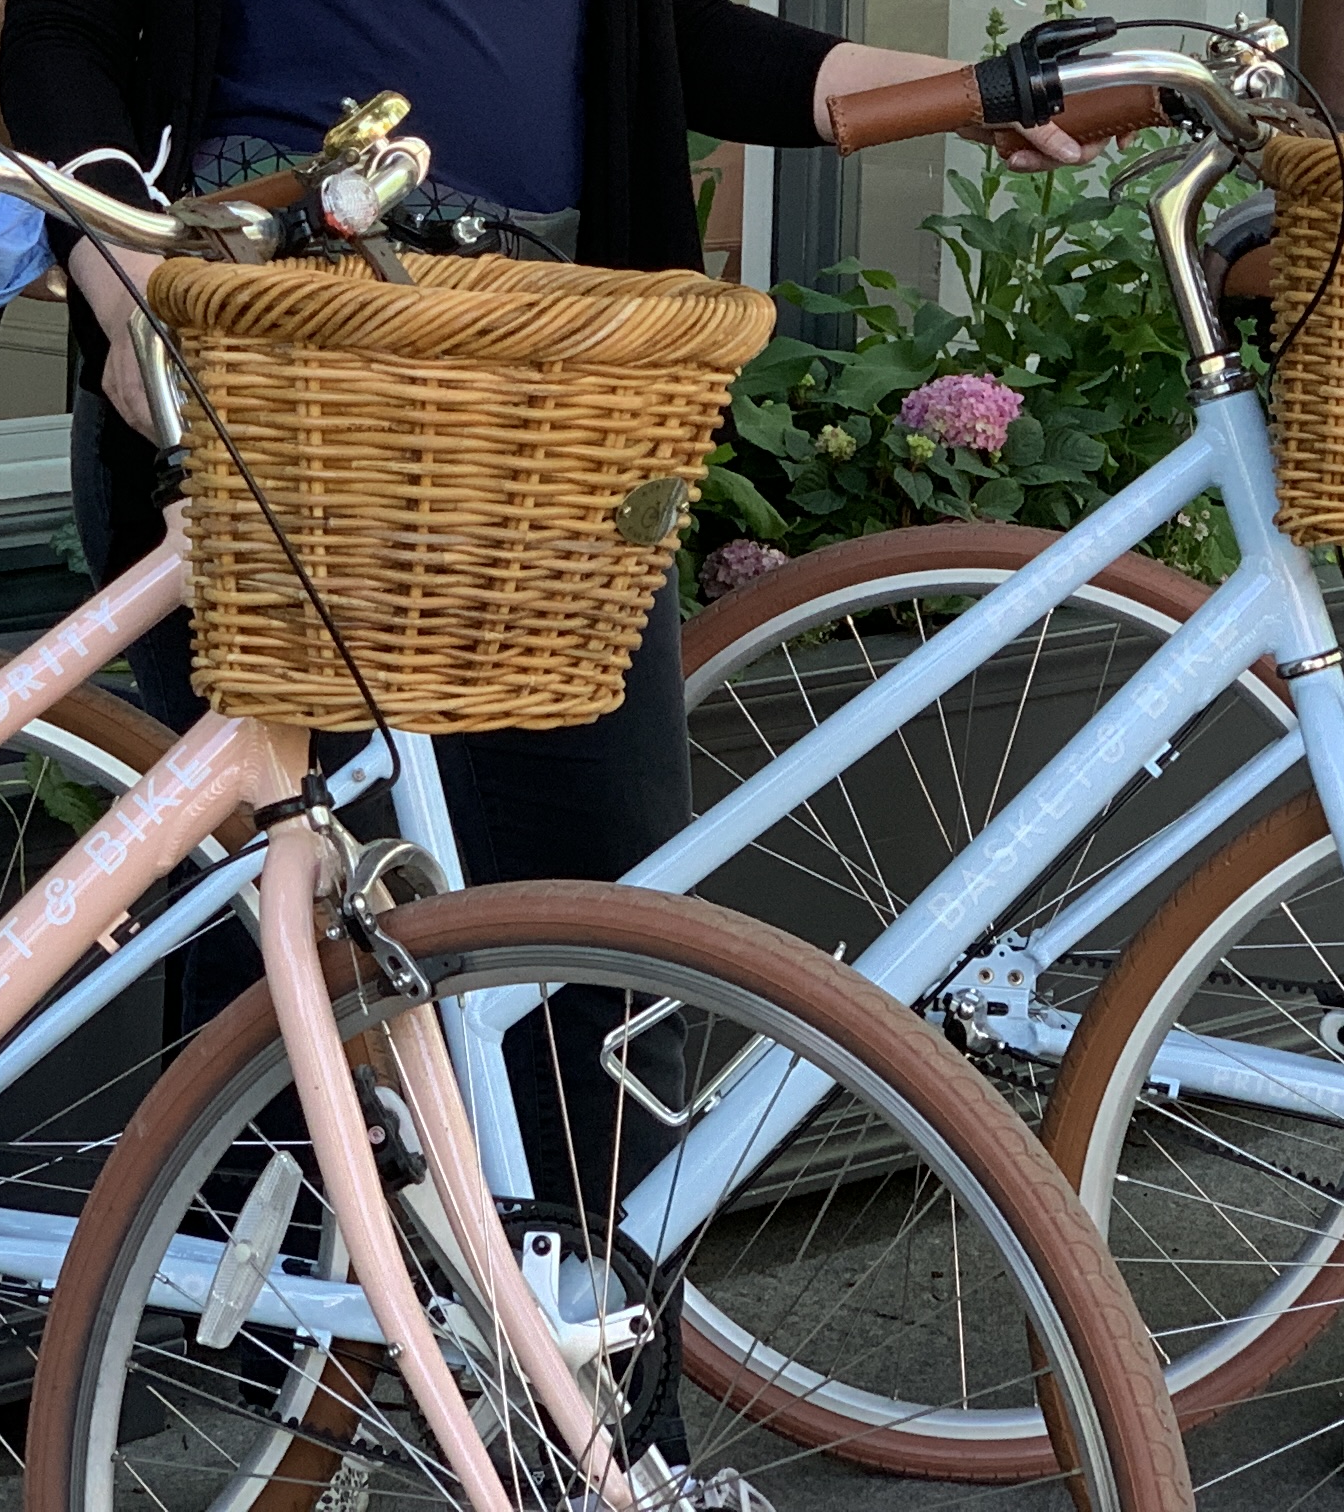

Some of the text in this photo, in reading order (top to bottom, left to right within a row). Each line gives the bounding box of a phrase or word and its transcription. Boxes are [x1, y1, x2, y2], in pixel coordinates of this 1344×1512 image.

[45, 876, 77, 927] &
[83, 744, 213, 876] BIKE
[925, 754, 1093, 931] BASKET
